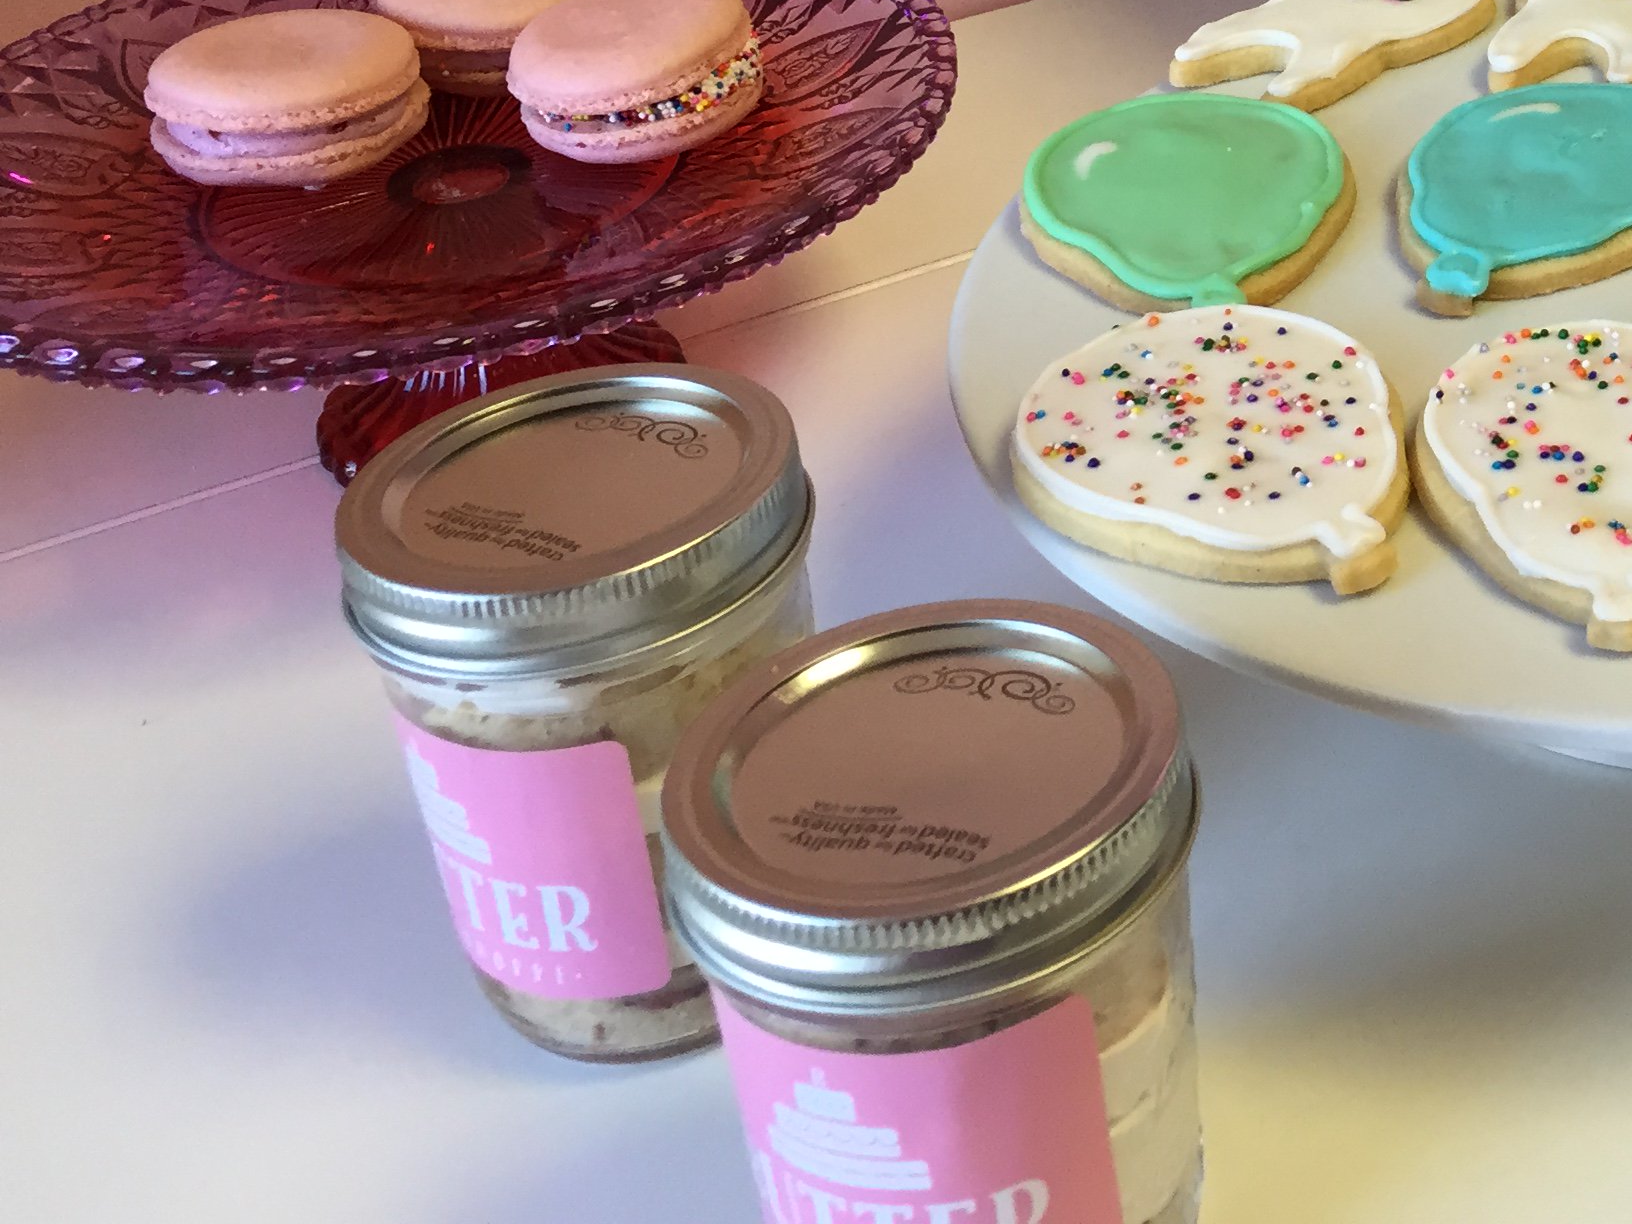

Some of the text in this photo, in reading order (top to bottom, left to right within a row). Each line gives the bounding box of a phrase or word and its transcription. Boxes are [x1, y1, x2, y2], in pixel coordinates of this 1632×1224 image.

[501, 538, 564, 561] crafted
[525, 529, 582, 552] sealed
[792, 815, 896, 839] freshness
[917, 825, 991, 849] sealed
[788, 830, 871, 852] quality
[893, 840, 977, 863] crafted
[434, 842, 599, 953] TER
